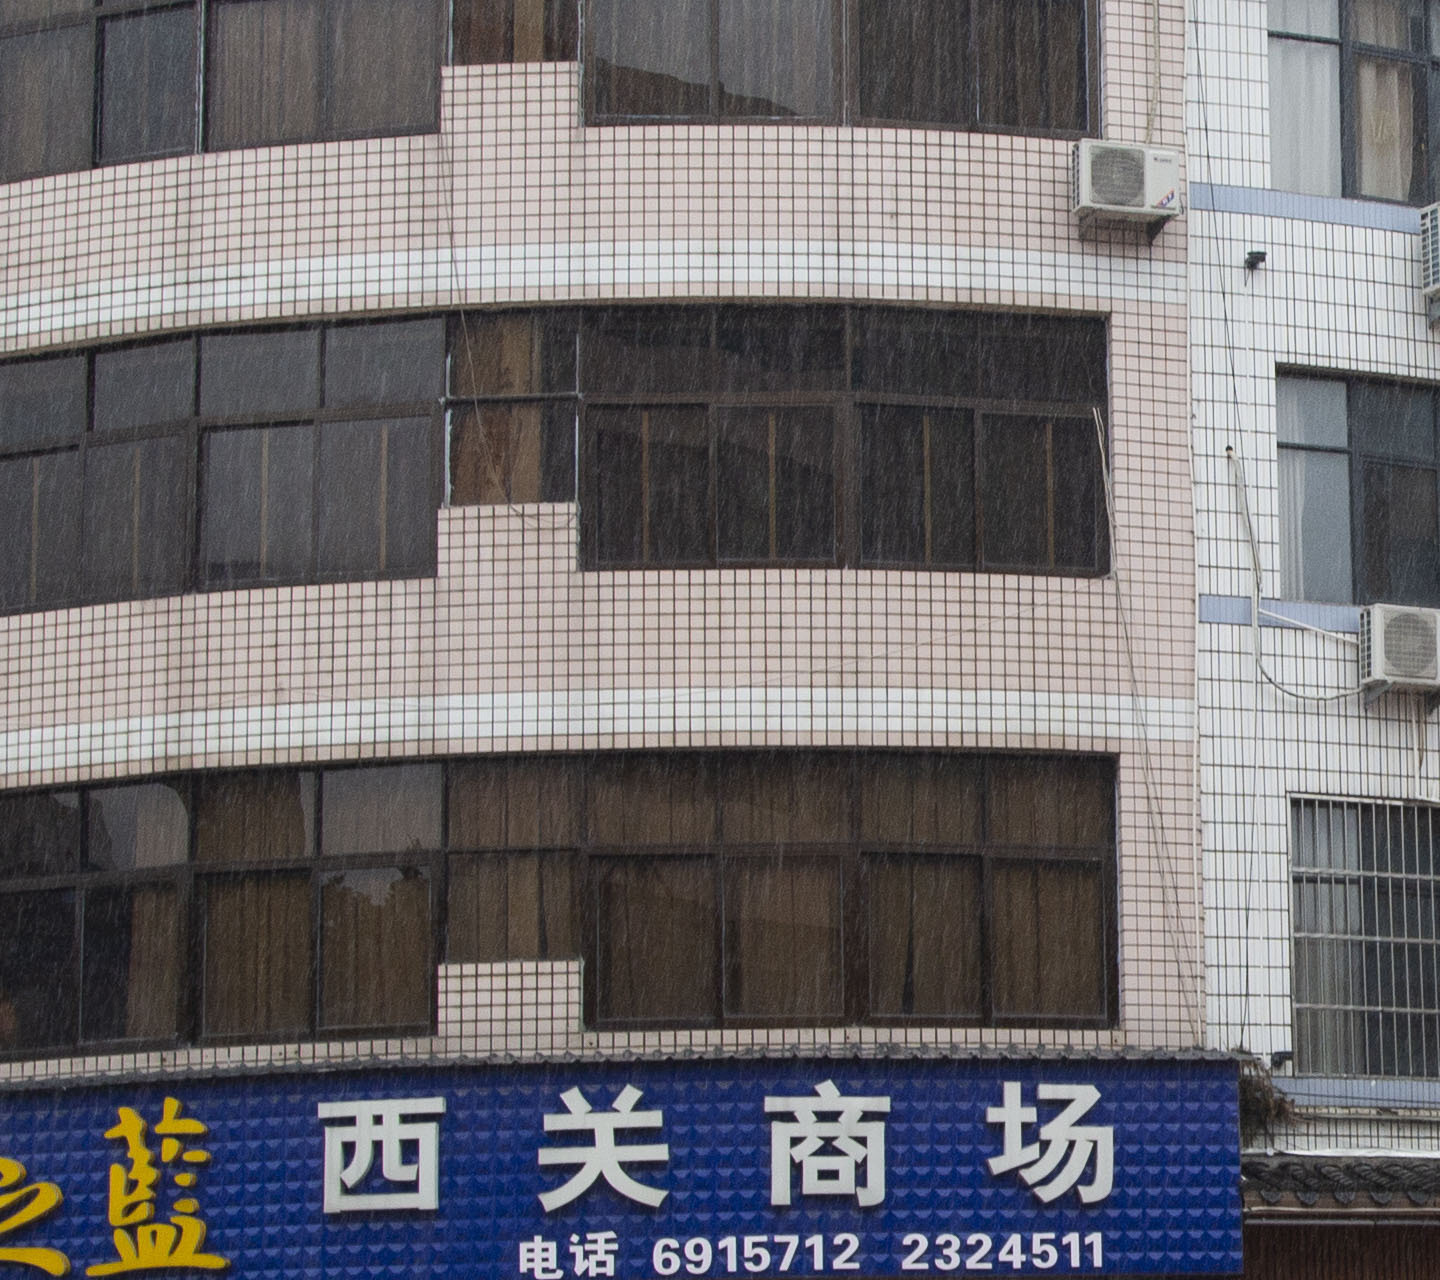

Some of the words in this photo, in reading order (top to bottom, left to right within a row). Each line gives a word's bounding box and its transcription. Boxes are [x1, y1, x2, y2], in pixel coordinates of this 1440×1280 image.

[317, 1079, 1115, 1214] 西关商场
[518, 1231, 620, 1280] 电话
[652, 1232, 861, 1276] 6915712
[901, 1231, 1105, 1272] 2324511
